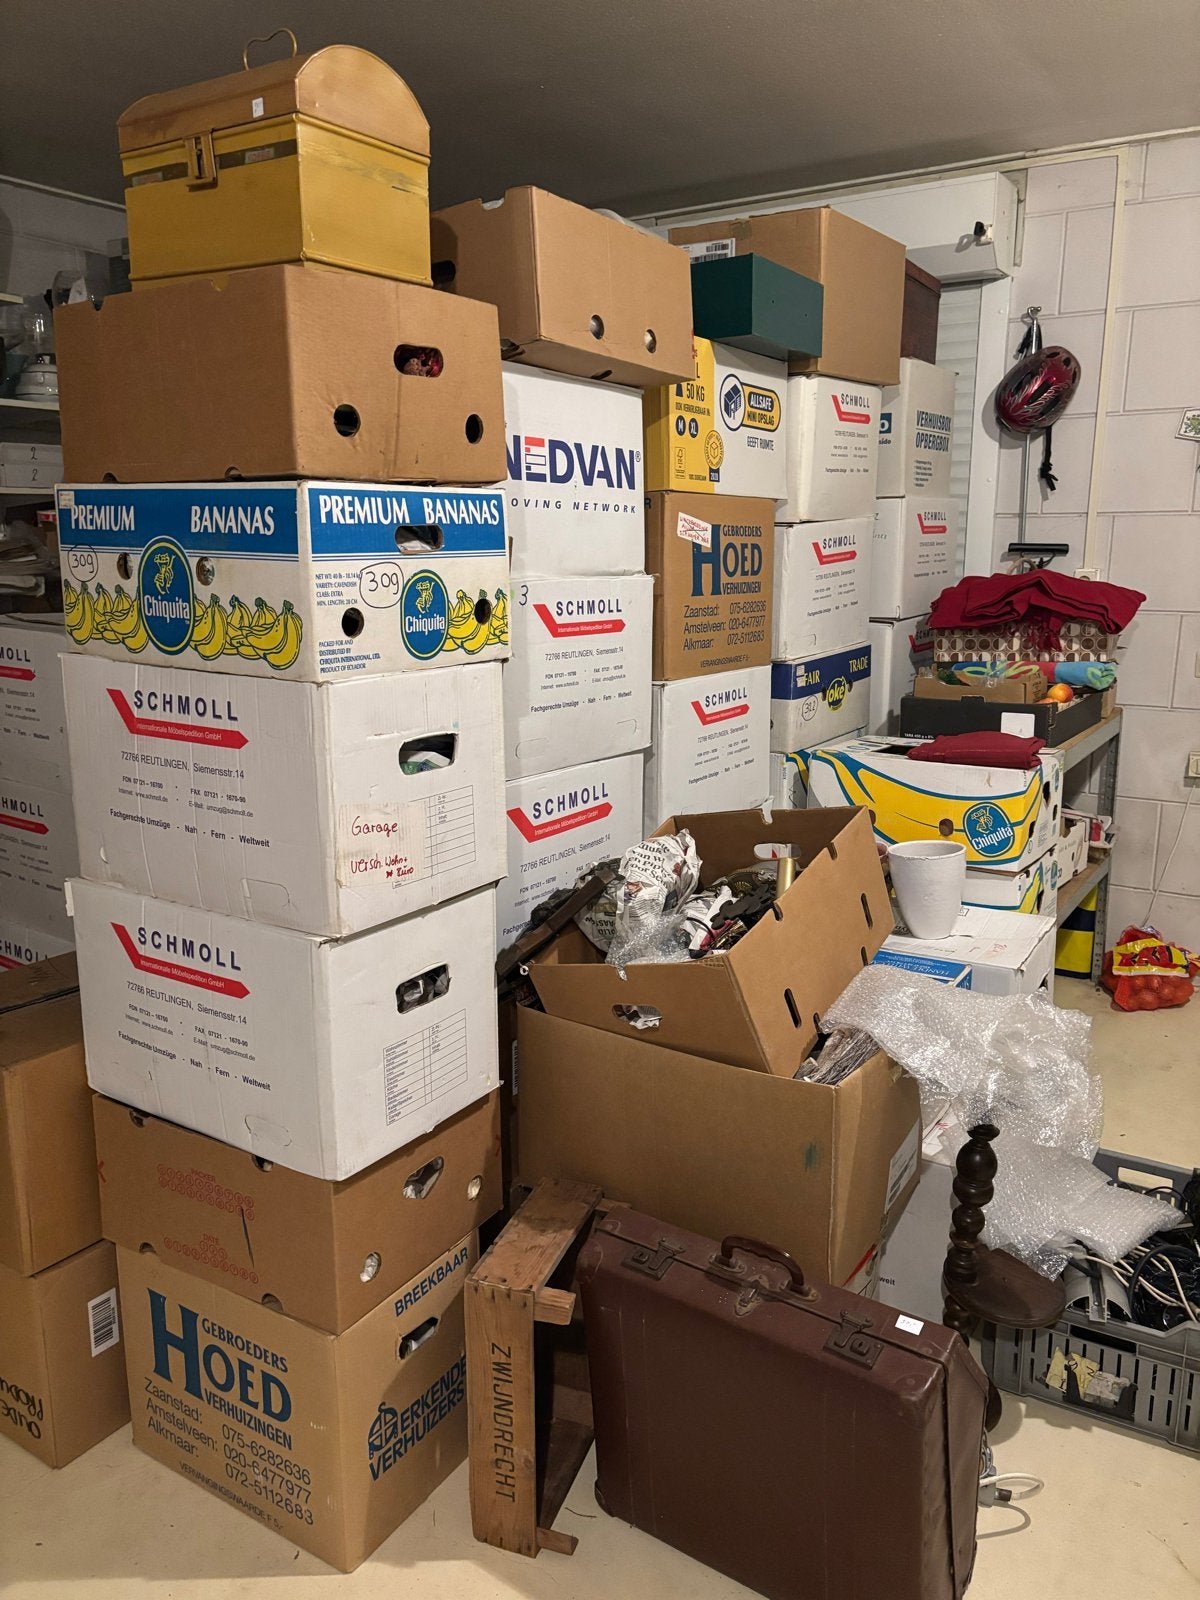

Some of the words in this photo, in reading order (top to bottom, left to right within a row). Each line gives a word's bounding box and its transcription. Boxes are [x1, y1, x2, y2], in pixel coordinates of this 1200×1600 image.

[687, 383, 694, 399] 50
[696, 385, 704, 401] KG
[750, 393, 772, 410] ALLSAFE
[841, 393, 870, 408] SCHMOLL
[691, 422, 696, 434] XL
[747, 411, 757, 422] MINI
[758, 413, 774, 426] OPSLAG
[917, 410, 951, 432] VERHUISBOX
[916, 432, 949, 452] OPBERGBOX
[319, 495, 410, 525] PREMIUM
[423, 498, 499, 525] BANANAS
[511, 498, 561, 509] OVING
[573, 502, 635, 513] NETWORK
[71, 505, 134, 531] PREMIUM
[191, 506, 274, 535] BANANAS
[924, 512, 946, 521] SCHMOLL
[723, 525, 762, 537] GEBROEDERS
[823, 535, 856, 549] SCHMOLL
[519, 585, 528, 606] 3
[723, 581, 761, 595] VERHUIZINGEN
[144, 595, 190, 623] Chiquita
[556, 599, 622, 616] SCHMOLL
[684, 605, 719, 618] Zaanstad:
[406, 614, 444, 635] Chiquita
[683, 620, 726, 634] Amstelveen:
[0, 647, 30, 662] MOLL
[683, 638, 714, 651] Alkmaar:
[805, 670, 819, 686] FAIR
[850, 656, 868, 673] TRADE
[134, 690, 238, 721] SCHMOLL
[705, 687, 747, 707] SCHMOLL
[205, 732, 221, 740] GmbH
[121, 751, 139, 762] 72766
[141, 754, 189, 772] REUTLINGEN,
[2, 797, 43, 817] HMOLL
[533, 783, 608, 819] SCHMOLL
[110, 809, 145, 823] Fachgerechte
[146, 816, 170, 829] Umzüge
[185, 824, 198, 834] Nah
[211, 830, 225, 840] Fern
[239, 835, 269, 847] Weltweit
[352, 816, 398, 837] Garage
[972, 825, 1013, 851] Chiquita
[520, 859, 538, 872] 72766
[539, 846, 577, 868] REUTLINGEN,
[138, 927, 241, 970] SCHMOLL
[208, 978, 224, 988] GmbH
[127, 981, 145, 995] 72766
[146, 987, 193, 1011] REUTLINGEN,
[118, 1031, 152, 1051] Fachgerechte
[153, 1046, 176, 1060] Umzüge
[190, 1058, 202, 1068] Nah
[215, 1067, 229, 1078] Fern
[242, 1075, 271, 1091] Weltweit
[394, 1247, 468, 1317] BREEKBAAR
[147, 1287, 291, 1422] HOED
[202, 1318, 288, 1372] GEBROEDERS
[0, 1377, 43, 1421] PRODU
[205, 1388, 292, 1450] VERHUIZINGEN
[492, 1342, 515, 1502] ZWIJNDRECHT
[144, 1377, 202, 1423] Zaanstad:
[222, 1424, 311, 1485] 075-6282636
[369, 1382, 465, 1481] VERHUIZERS
[146, 1398, 218, 1451] Amstelveen:
[224, 1444, 311, 1503] 020-6477977
[148, 1417, 199, 1457] Alkmaar:
[225, 1463, 313, 1525] 072-5112683
